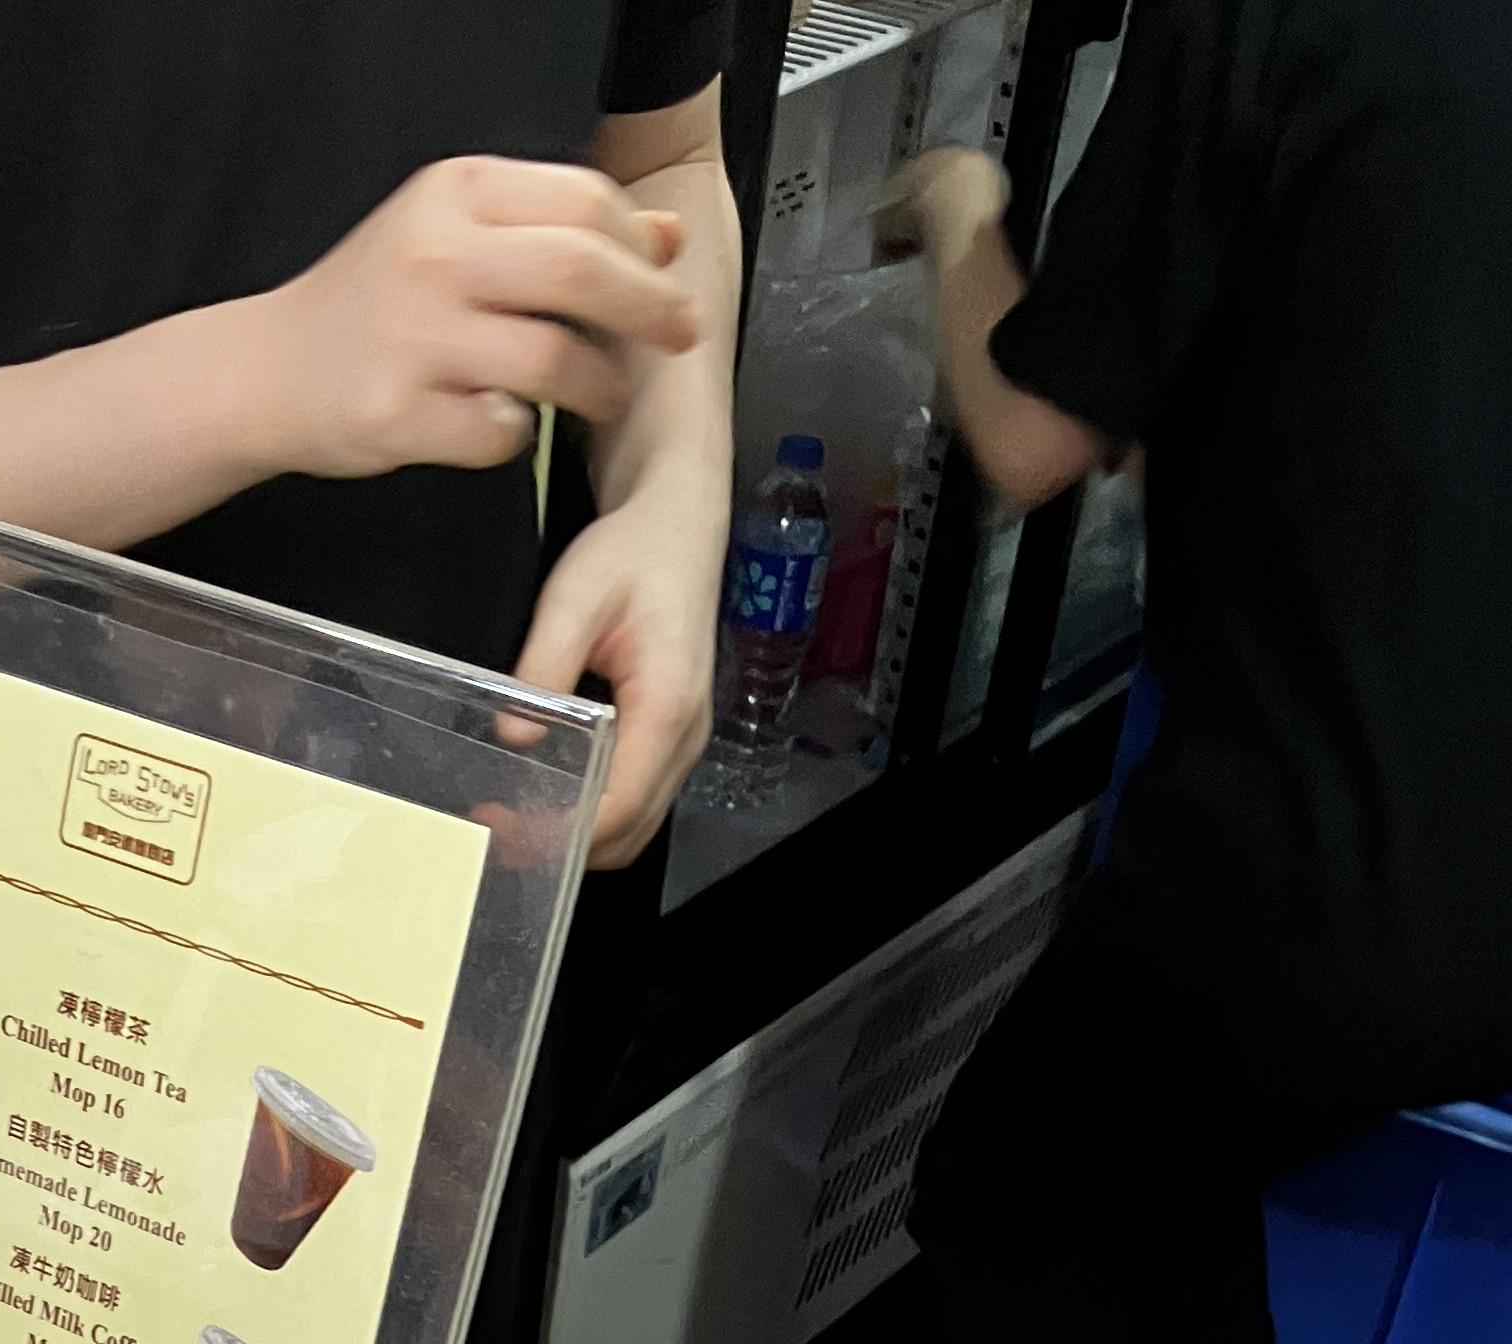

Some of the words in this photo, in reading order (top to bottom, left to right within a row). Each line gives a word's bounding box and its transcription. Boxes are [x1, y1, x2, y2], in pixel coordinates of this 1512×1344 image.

[84, 748, 129, 775] LORD
[136, 765, 195, 808] STOW'S
[108, 788, 164, 817] BAKERY
[56, 989, 151, 1046] 凍檸檬茶
[0, 1014, 72, 1060] Chilled
[77, 1042, 146, 1088] Lemon
[153, 1070, 188, 1104] Tea
[50, 1071, 97, 1113] Mop
[103, 1093, 128, 1120] 16
[7, 1113, 165, 1197] 自製特色檸檬水
[37, 1204, 84, 1245] Mop
[89, 1226, 113, 1253] 20
[83, 1186, 186, 1247] Lemonade
[9, 1245, 122, 1312] 凍牛奶咖啡
[38, 1300, 85, 1337] Milk
